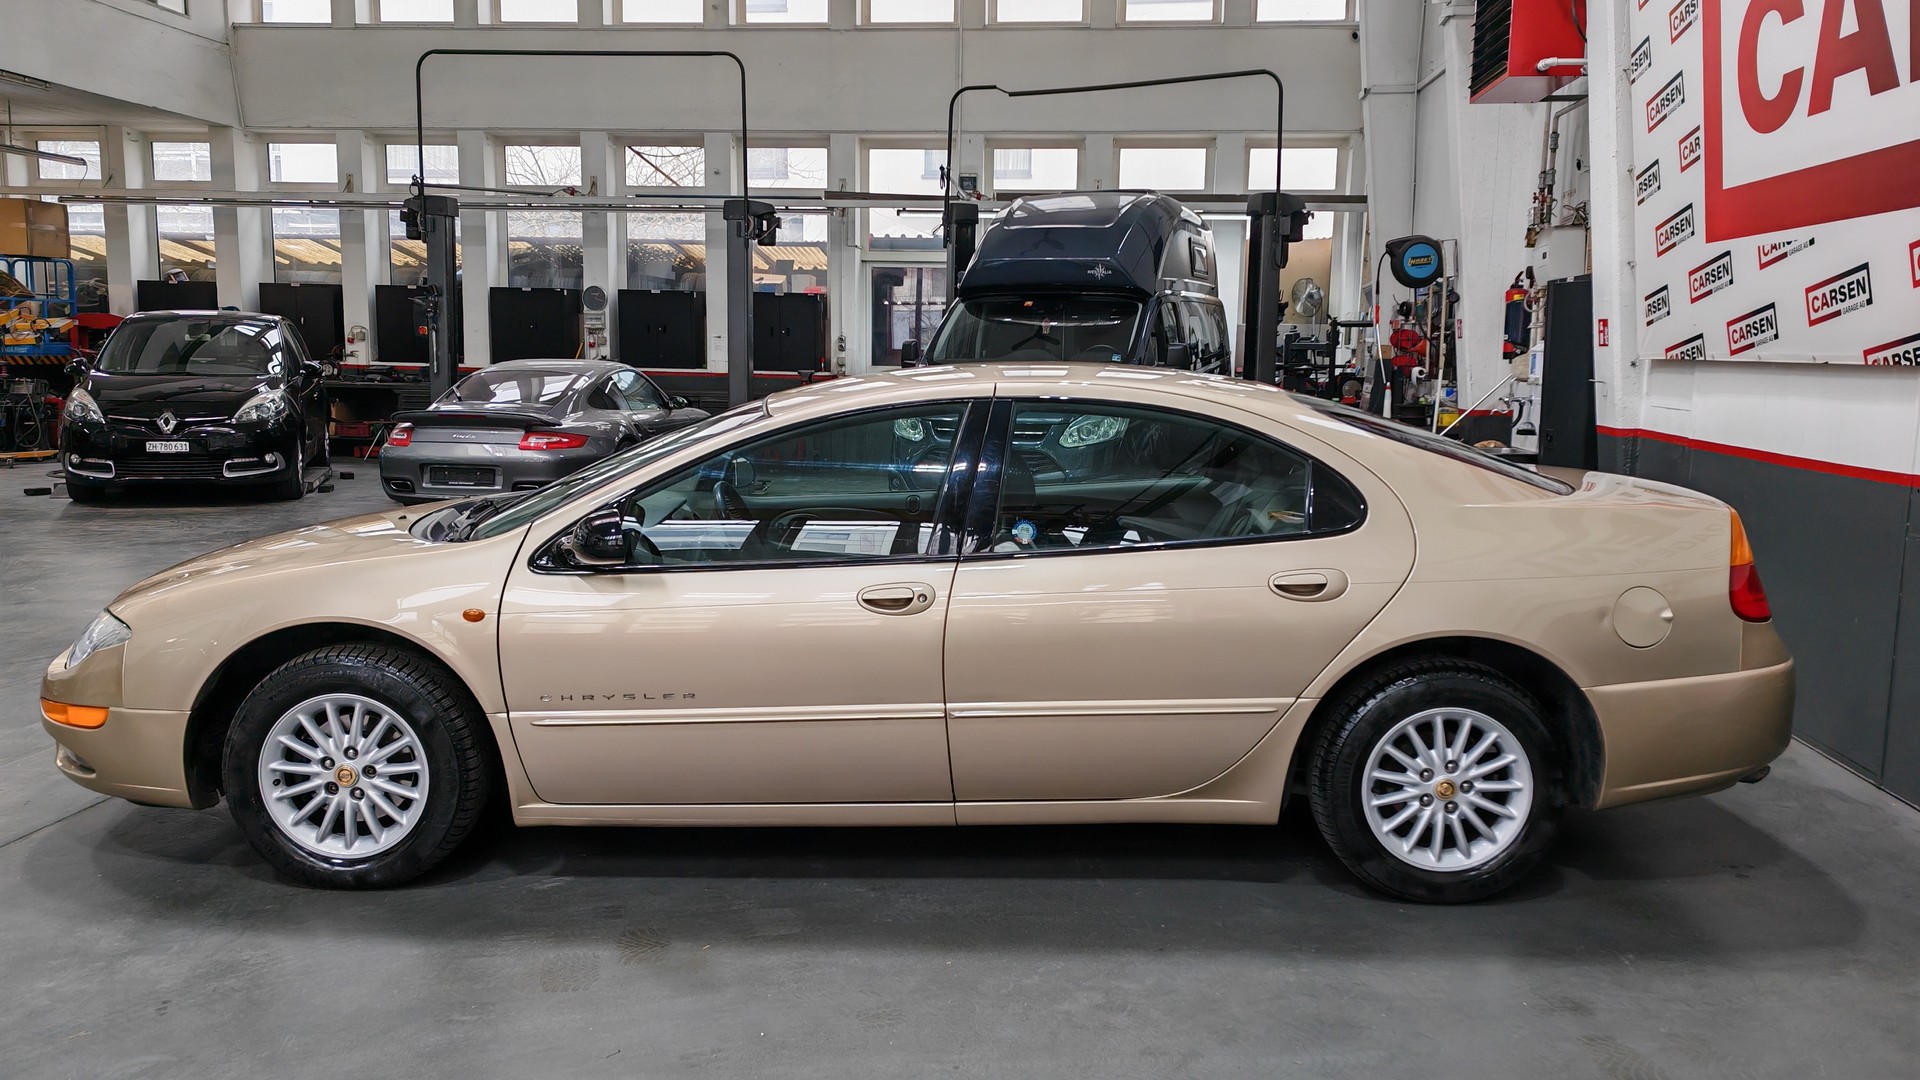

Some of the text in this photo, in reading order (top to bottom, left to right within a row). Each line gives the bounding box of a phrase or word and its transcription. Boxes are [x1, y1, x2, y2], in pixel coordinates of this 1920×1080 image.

[1673, 0, 1698, 31] CARS
[1737, 0, 1920, 134] CA
[1650, 82, 1682, 121] CARSEN
[1636, 169, 1658, 198] RSEN
[1659, 213, 1692, 247] CARSEN
[1692, 261, 1730, 293] CARSEN
[1645, 294, 1668, 318] RSEN
[1811, 276, 1867, 314] CARSEN
[1842, 301, 1866, 315] GARAGE AG
[1731, 314, 1774, 345] CARSEN
[540, 692, 696, 702] CHRYSLER
